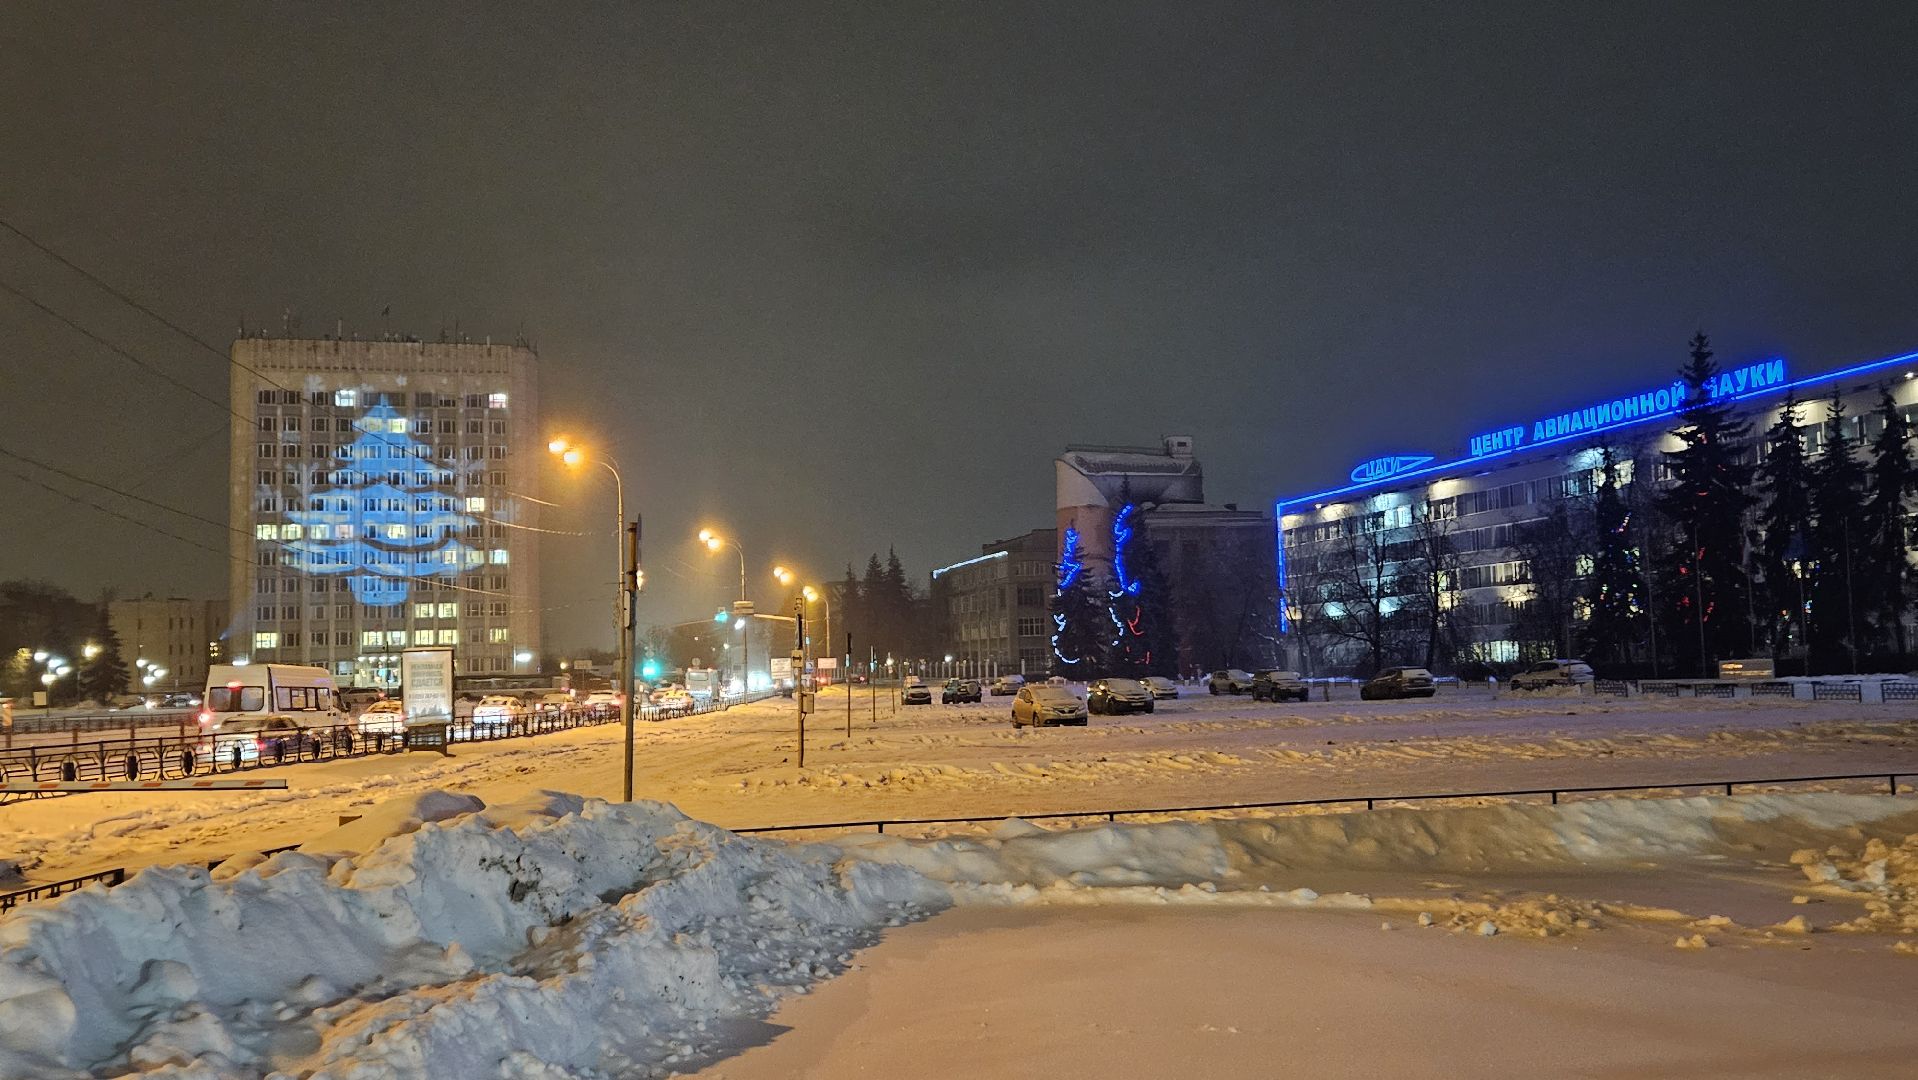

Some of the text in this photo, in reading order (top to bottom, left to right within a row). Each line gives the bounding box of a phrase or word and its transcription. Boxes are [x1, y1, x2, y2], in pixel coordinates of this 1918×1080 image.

[1471, 426, 1524, 456] ЦЕНТР
[1533, 380, 1686, 441] АВИАЦИОННОЙ
[1365, 456, 1400, 478] ЦАГИ
